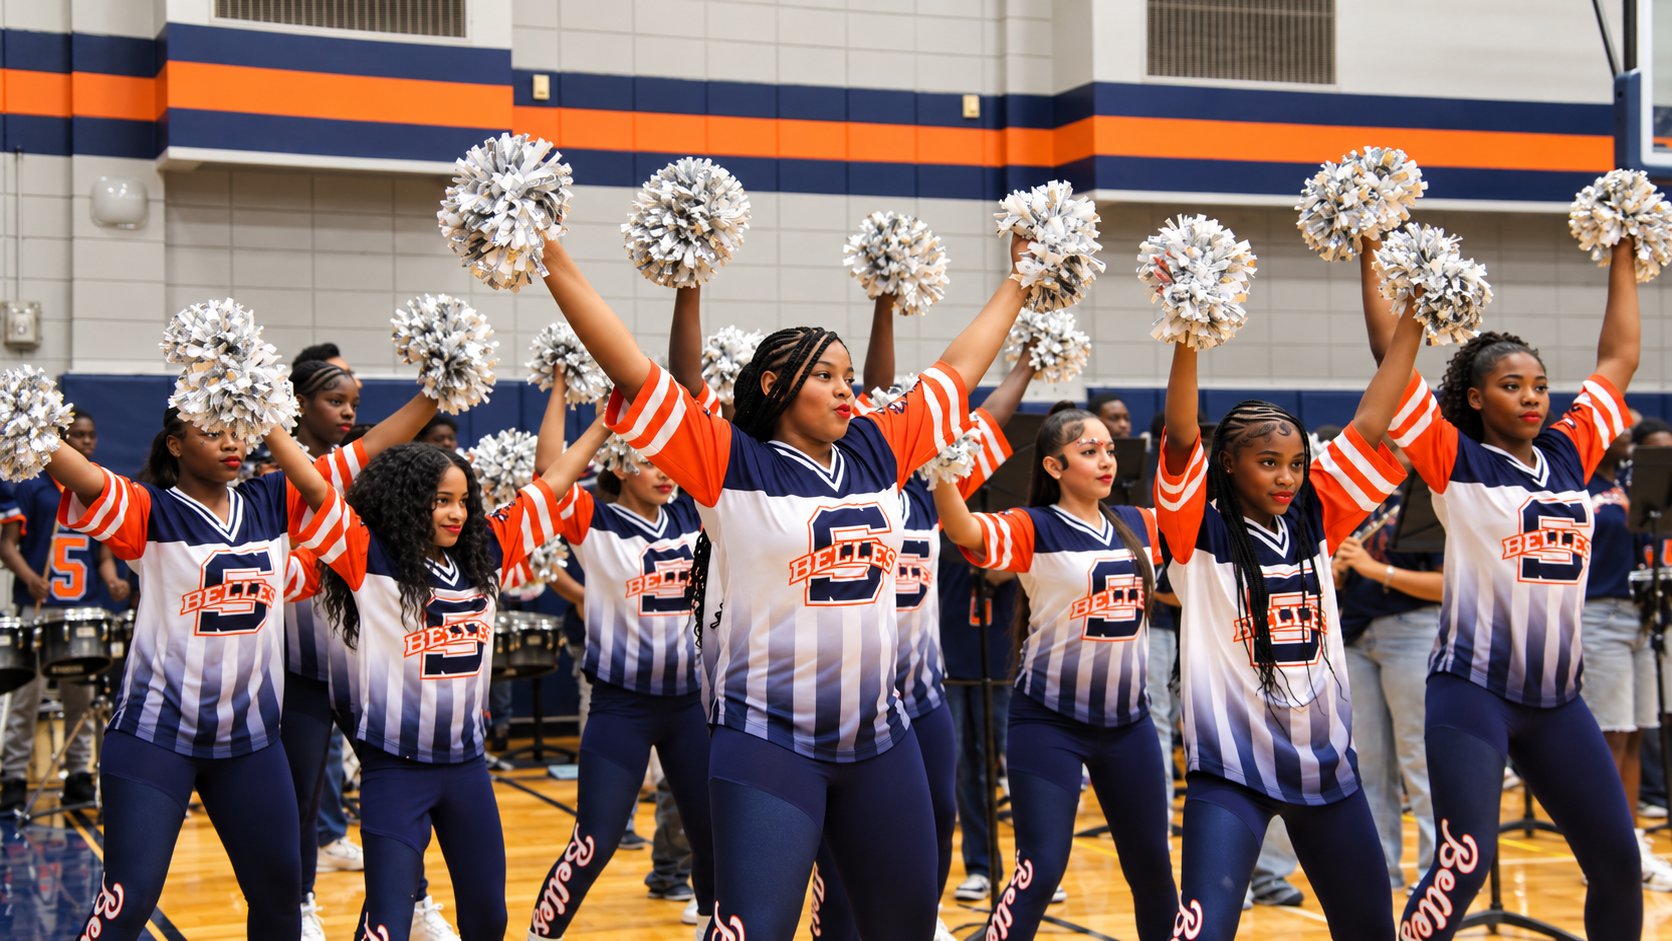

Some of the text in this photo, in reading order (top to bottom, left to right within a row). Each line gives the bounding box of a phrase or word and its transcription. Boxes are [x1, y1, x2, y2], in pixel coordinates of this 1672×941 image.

[51, 533, 89, 601] 5
[789, 537, 897, 586] BELLES
[805, 501, 892, 607] S
[1502, 528, 1591, 561] BELLES
[1517, 495, 1590, 586] S
[180, 583, 276, 616] BELLES
[194, 546, 275, 637] S
[625, 567, 693, 599] BELL
[638, 540, 695, 617] S
[1070, 586, 1145, 621] BELLE
[403, 619, 492, 658] BELLES
[419, 594, 489, 680] S
[1233, 603, 1328, 643] BLLES
[532, 822, 595, 937] Belles
[985, 848, 1034, 941] Belle
